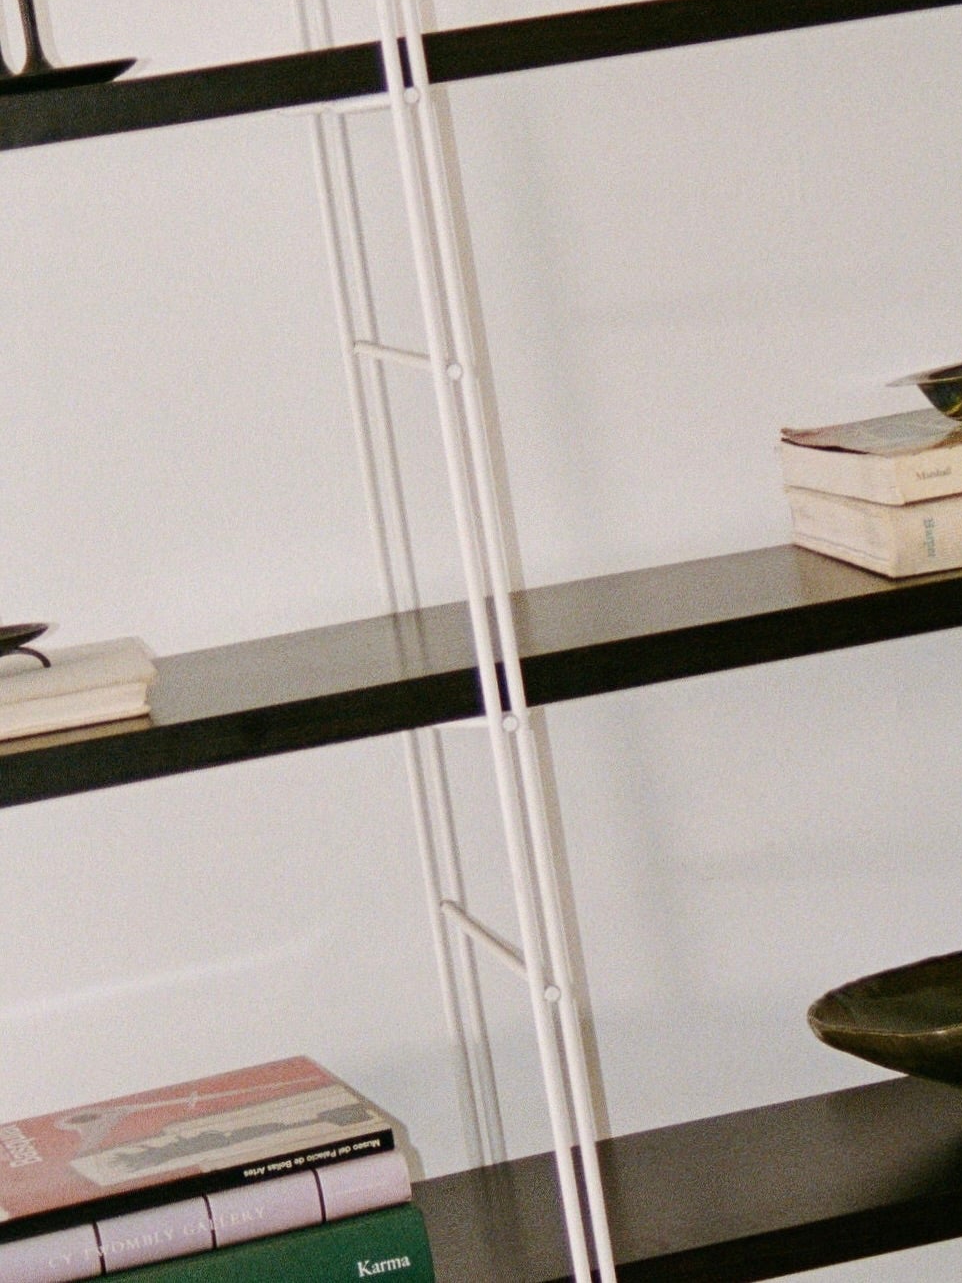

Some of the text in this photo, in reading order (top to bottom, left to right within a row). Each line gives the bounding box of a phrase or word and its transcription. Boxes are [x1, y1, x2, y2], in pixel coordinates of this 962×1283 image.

[352, 1137, 381, 1152] Museo
[306, 1149, 337, 1162] Palacio
[338, 1146, 351, 1157] del
[293, 1157, 305, 1166] de
[243, 1166, 266, 1178] Artes
[48, 1207, 267, 1271] CY TWOMBLY GALLERY
[356, 1255, 412, 1278] Karma
